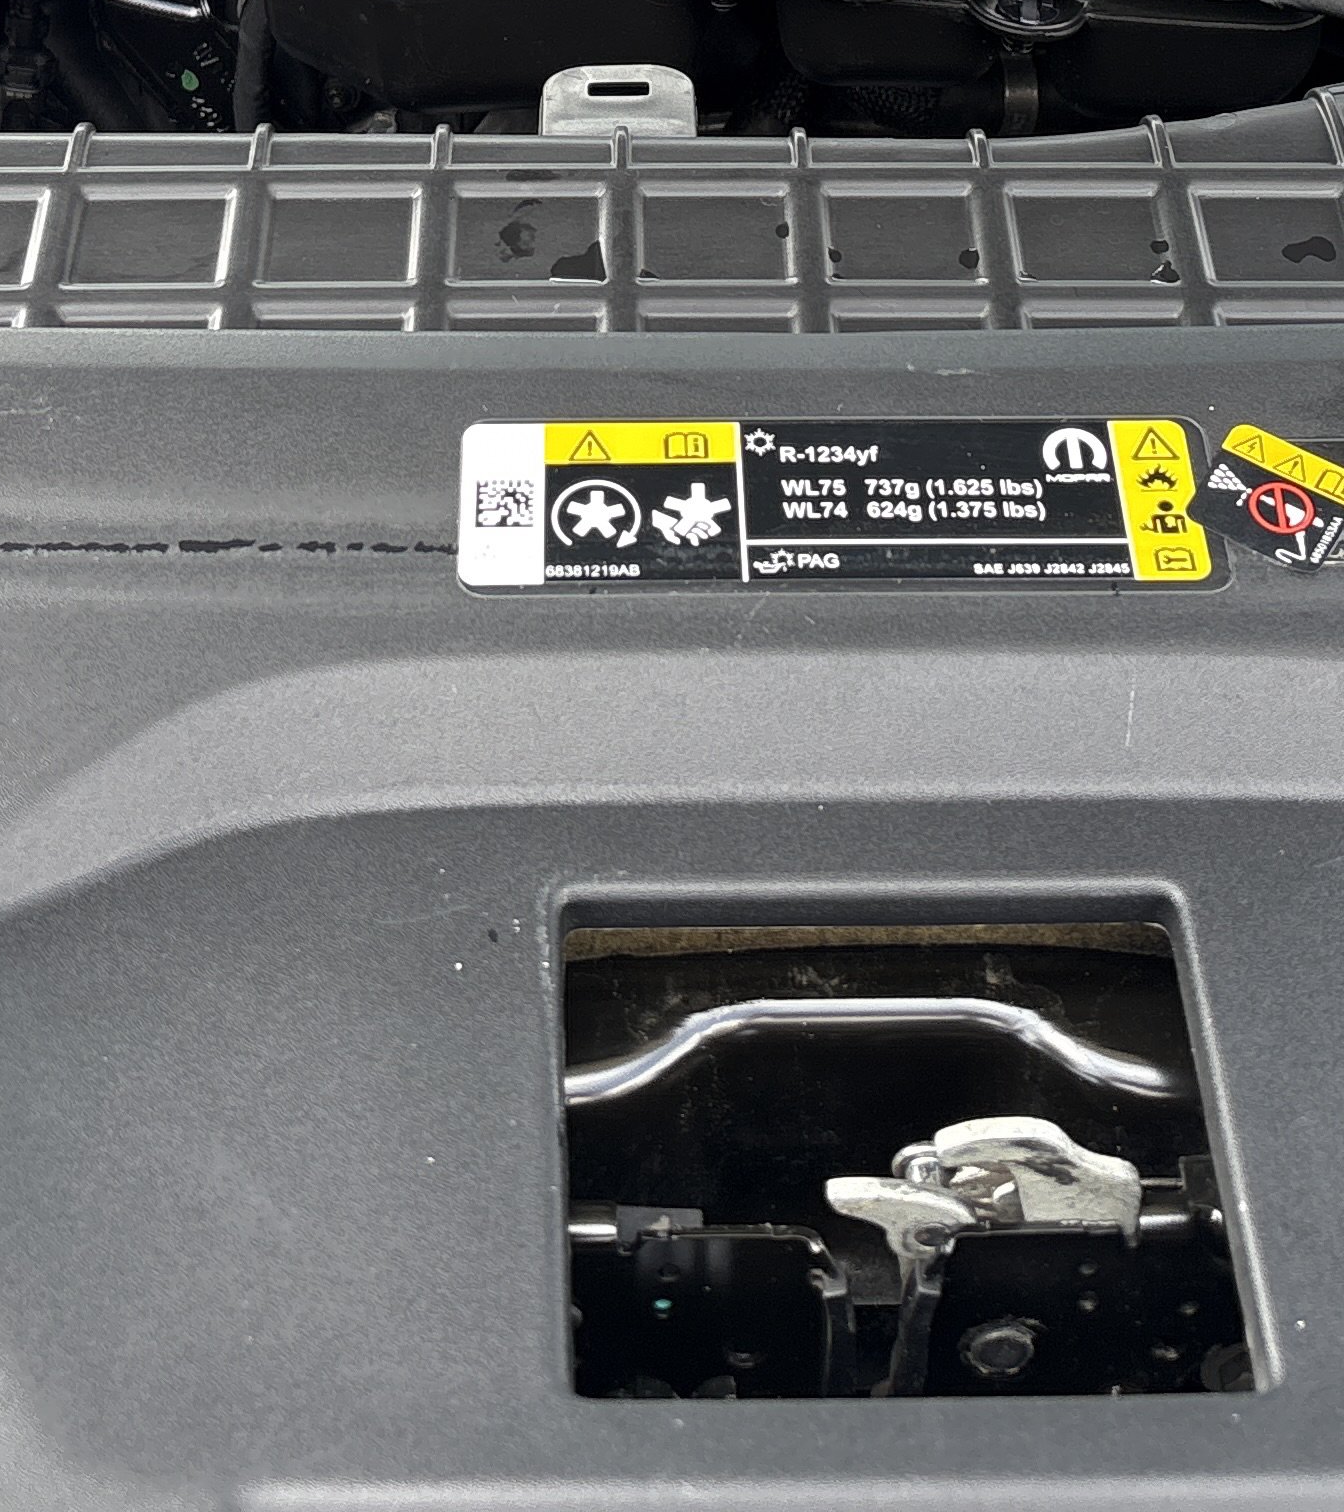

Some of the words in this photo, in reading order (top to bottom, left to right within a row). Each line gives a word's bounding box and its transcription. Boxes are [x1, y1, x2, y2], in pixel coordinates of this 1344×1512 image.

[778, 445, 880, 467] R-1234yf
[780, 478, 847, 497] WL75
[864, 478, 921, 500] 737g
[925, 478, 994, 499] (1.625
[1000, 478, 1044, 499] lbs)
[781, 501, 849, 519] WL74
[866, 501, 923, 522] 624g
[927, 501, 997, 522] (1.375
[1002, 501, 1047, 522] lbs)
[796, 553, 841, 569] PAG
[972, 562, 1005, 575] SAE
[1007, 562, 1042, 575] J639
[544, 563, 641, 578] 68381219AB
